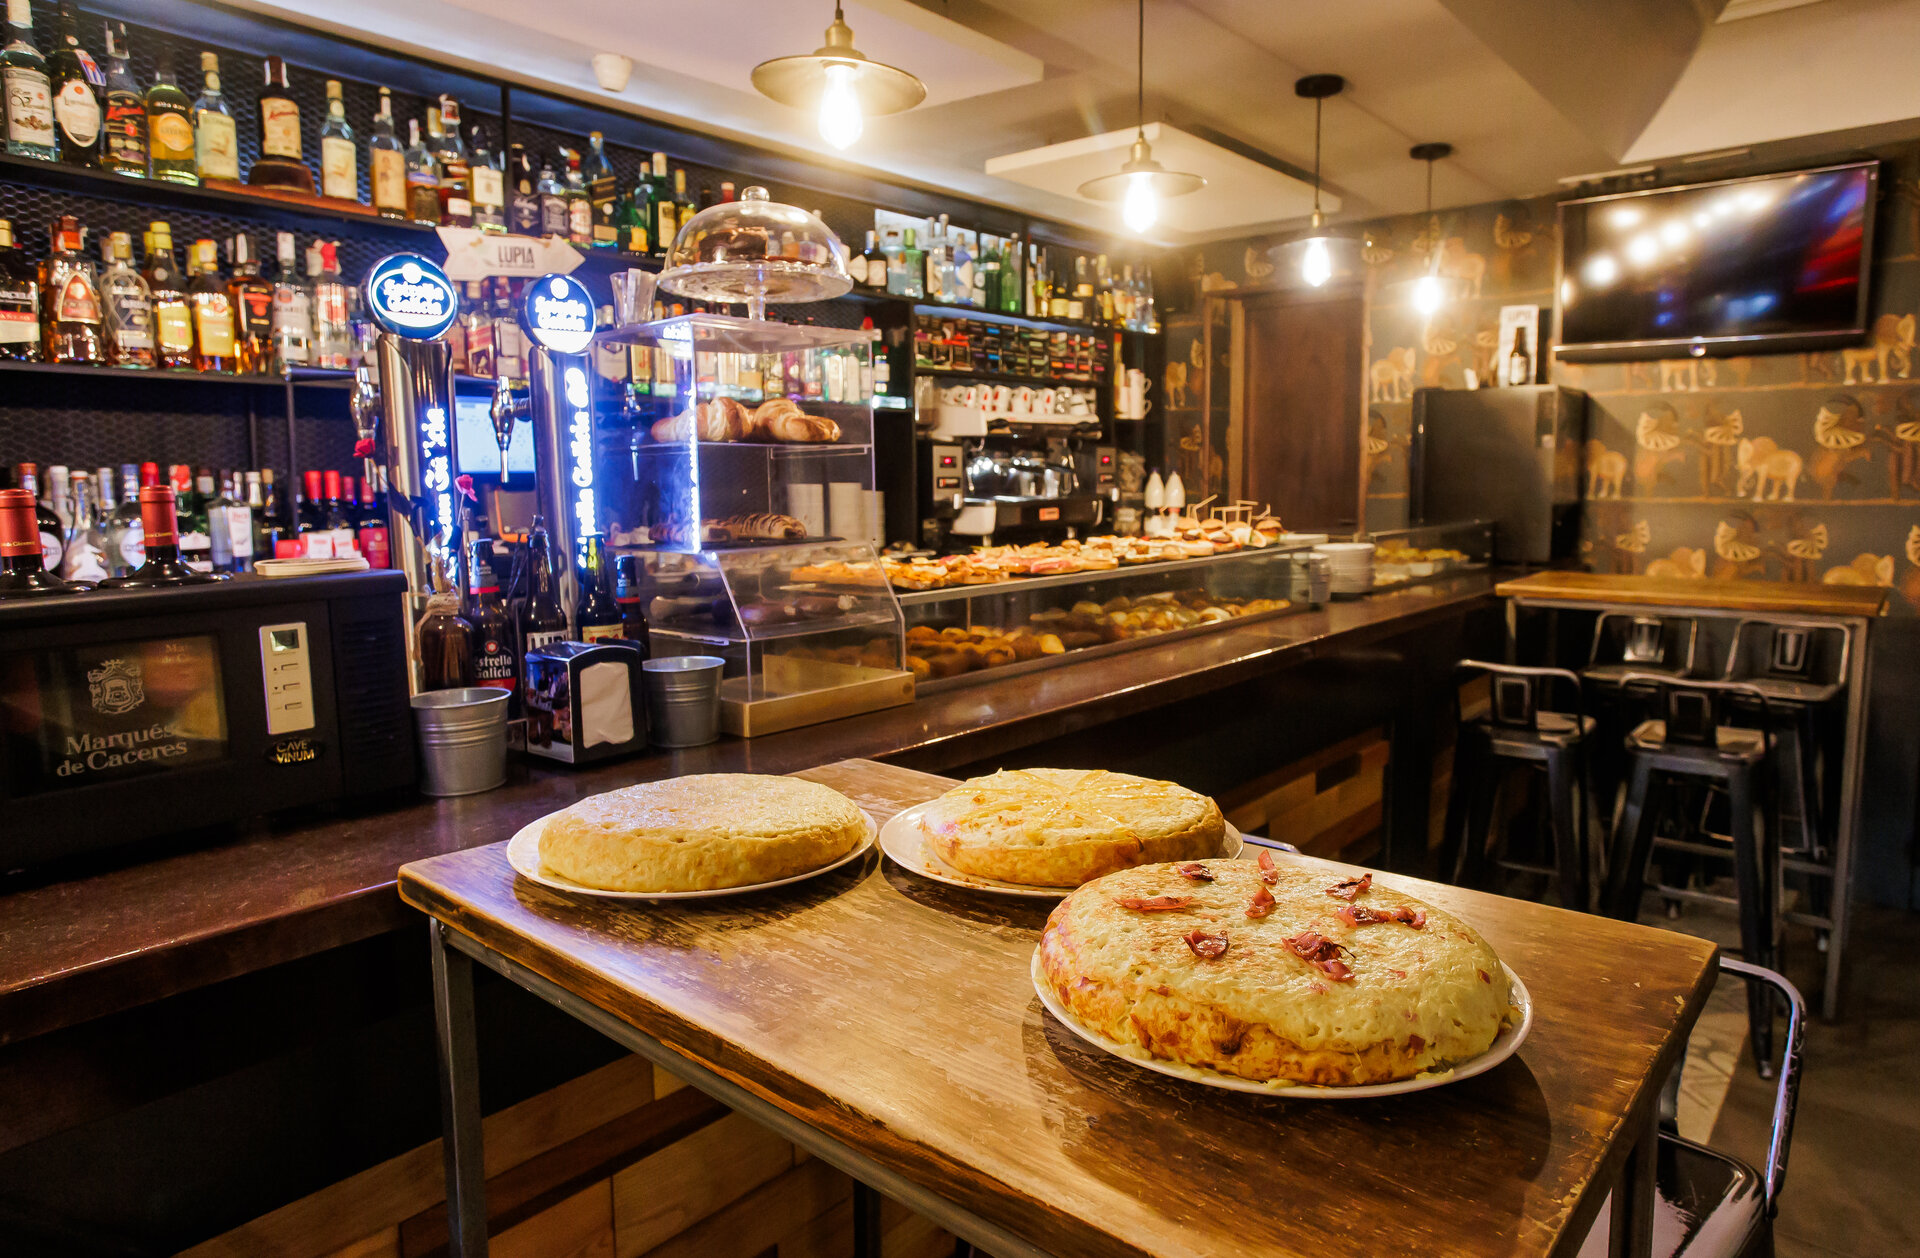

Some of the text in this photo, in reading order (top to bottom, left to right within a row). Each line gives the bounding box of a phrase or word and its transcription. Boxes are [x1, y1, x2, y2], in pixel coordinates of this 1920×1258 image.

[498, 246, 535, 264] LUPIA
[66, 723, 176, 755] Marqués
[276, 741, 308, 753] CAVE
[56, 741, 188, 777] de Caceres
[276, 749, 315, 764] VINUM
